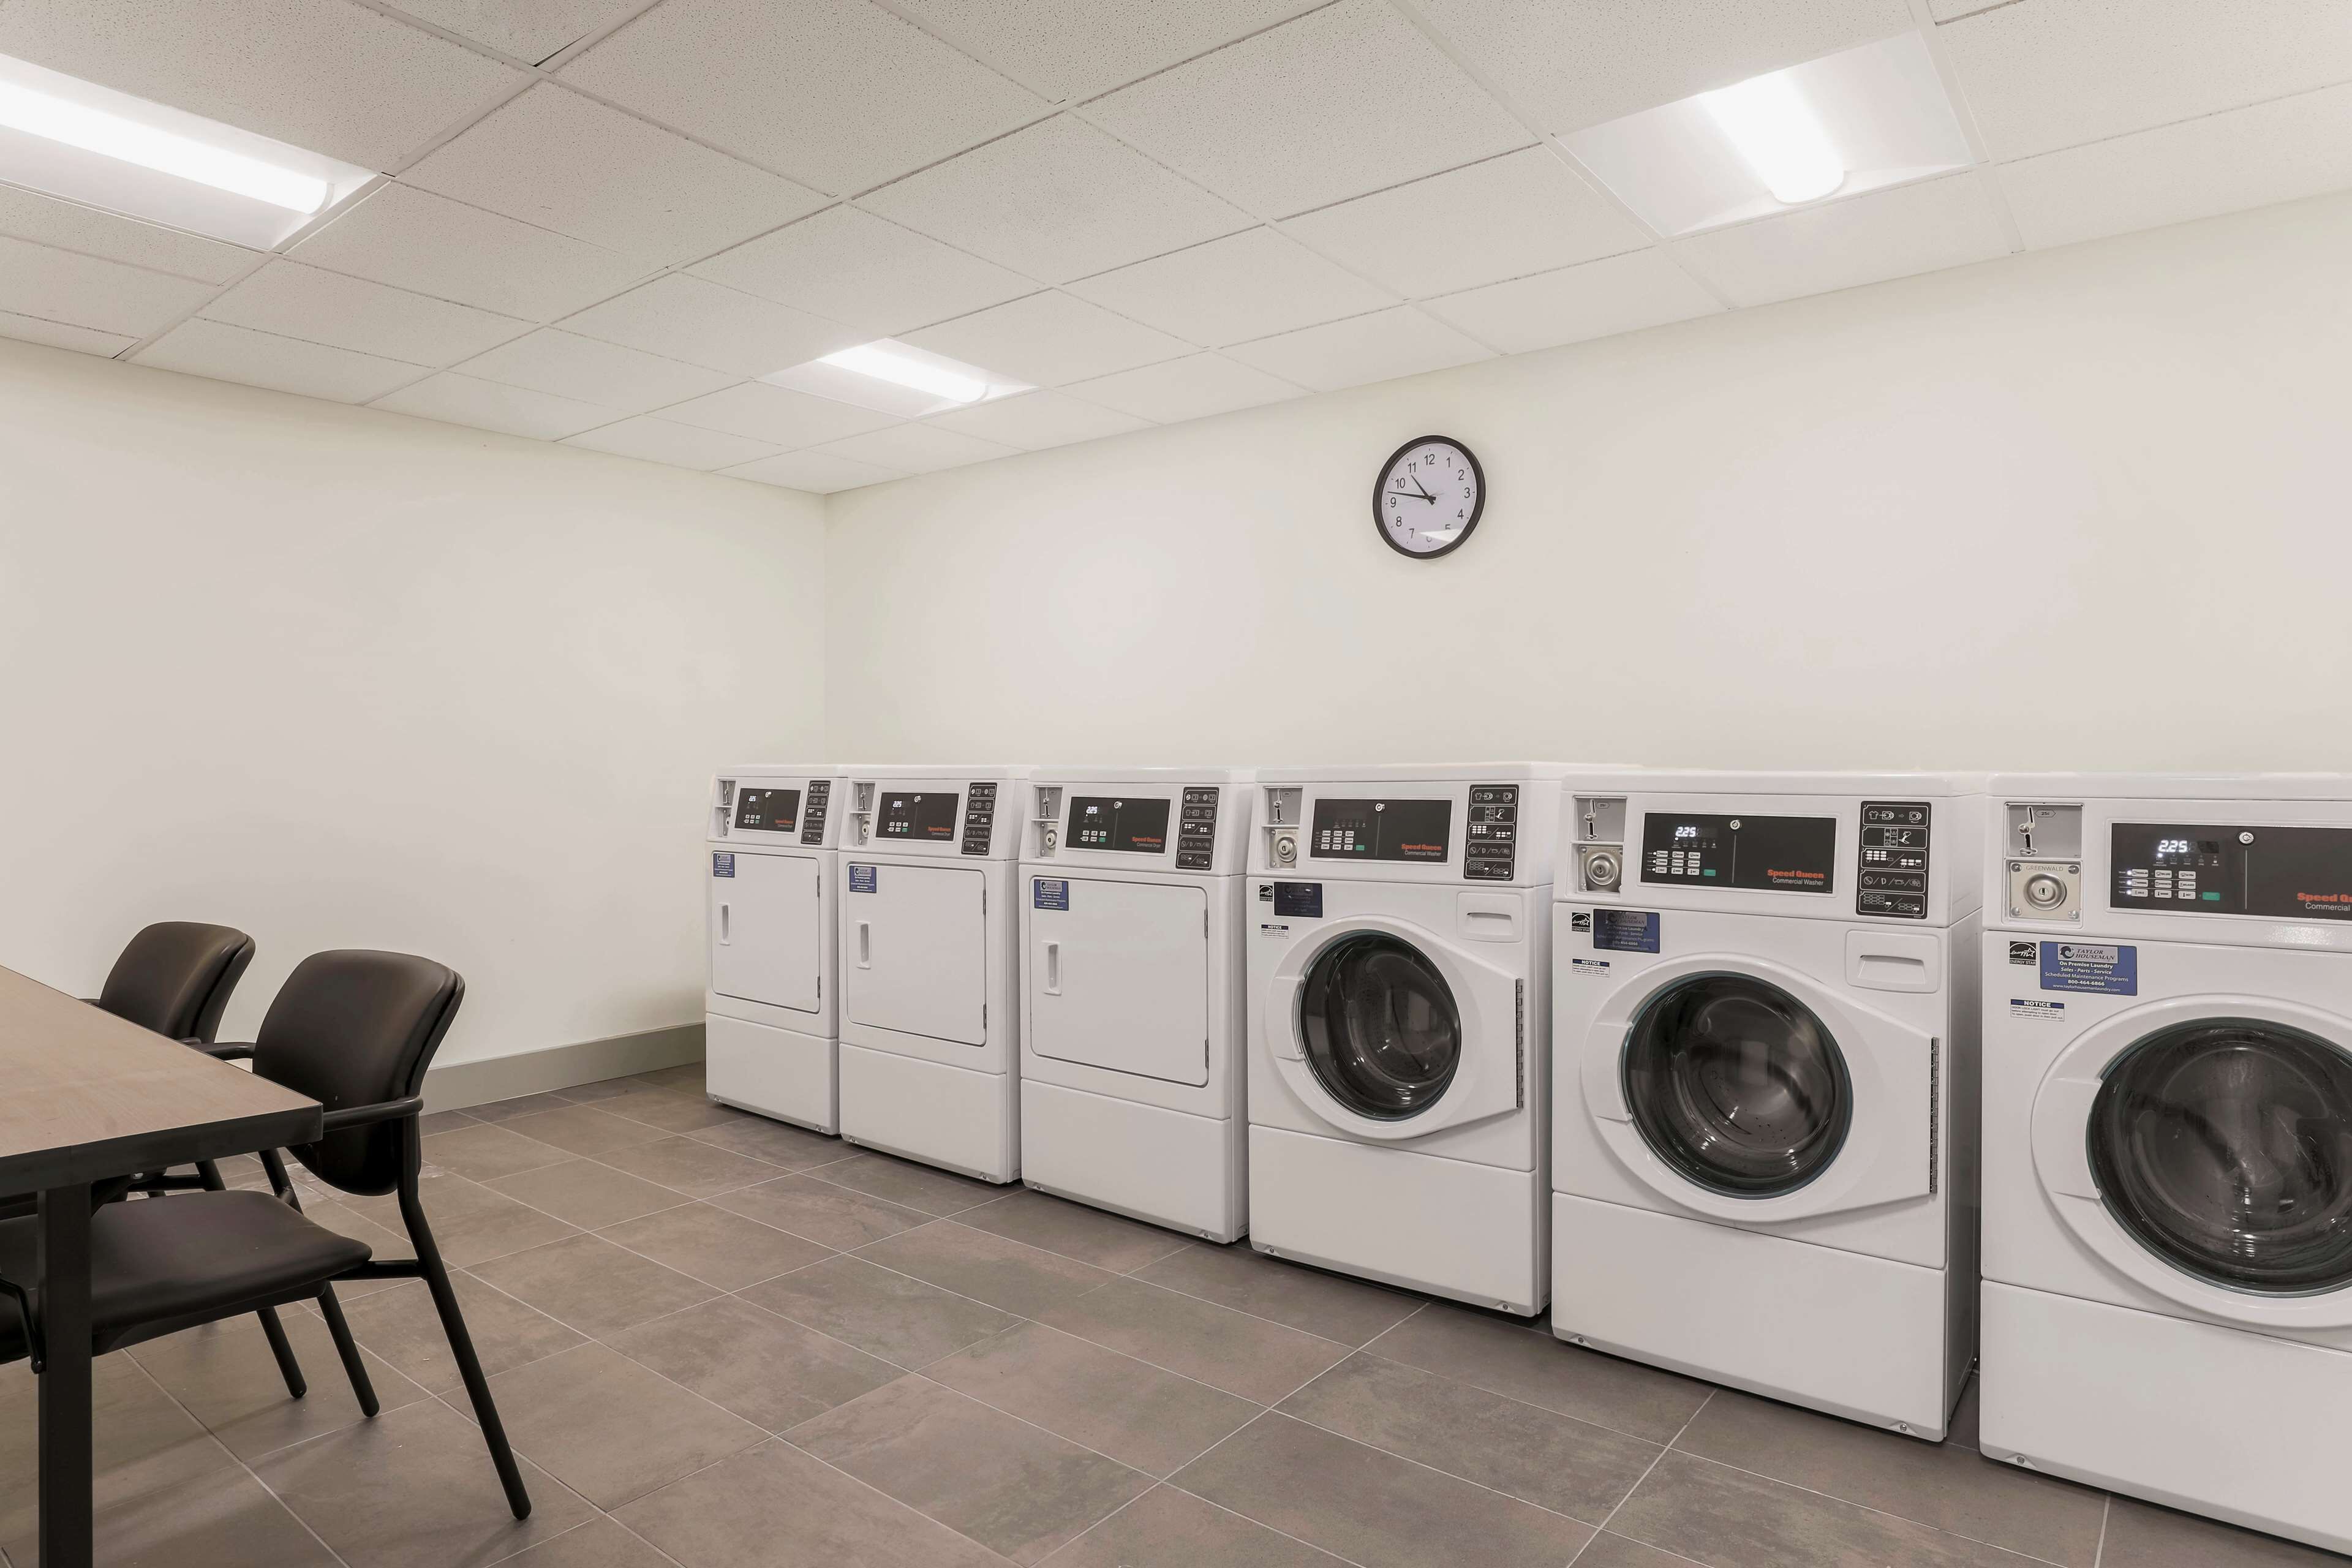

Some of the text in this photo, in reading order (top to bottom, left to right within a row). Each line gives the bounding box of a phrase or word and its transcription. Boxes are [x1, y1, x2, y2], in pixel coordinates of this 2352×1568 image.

[1424, 454, 1435, 466] 12
[1446, 457, 1450, 467] 1
[1408, 462, 1416, 473] 11
[1458, 469, 1464, 480] 2
[1395, 478, 1406, 489] 10
[1464, 487, 1471, 499] 3
[1390, 497, 1396, 508] 9
[1457, 508, 1464, 519] 4
[1396, 516, 1402, 527] 8
[1409, 528, 1415, 538] 7
[2297, 892, 2338, 902] Speed
[2305, 902, 2351, 911] Commercial
